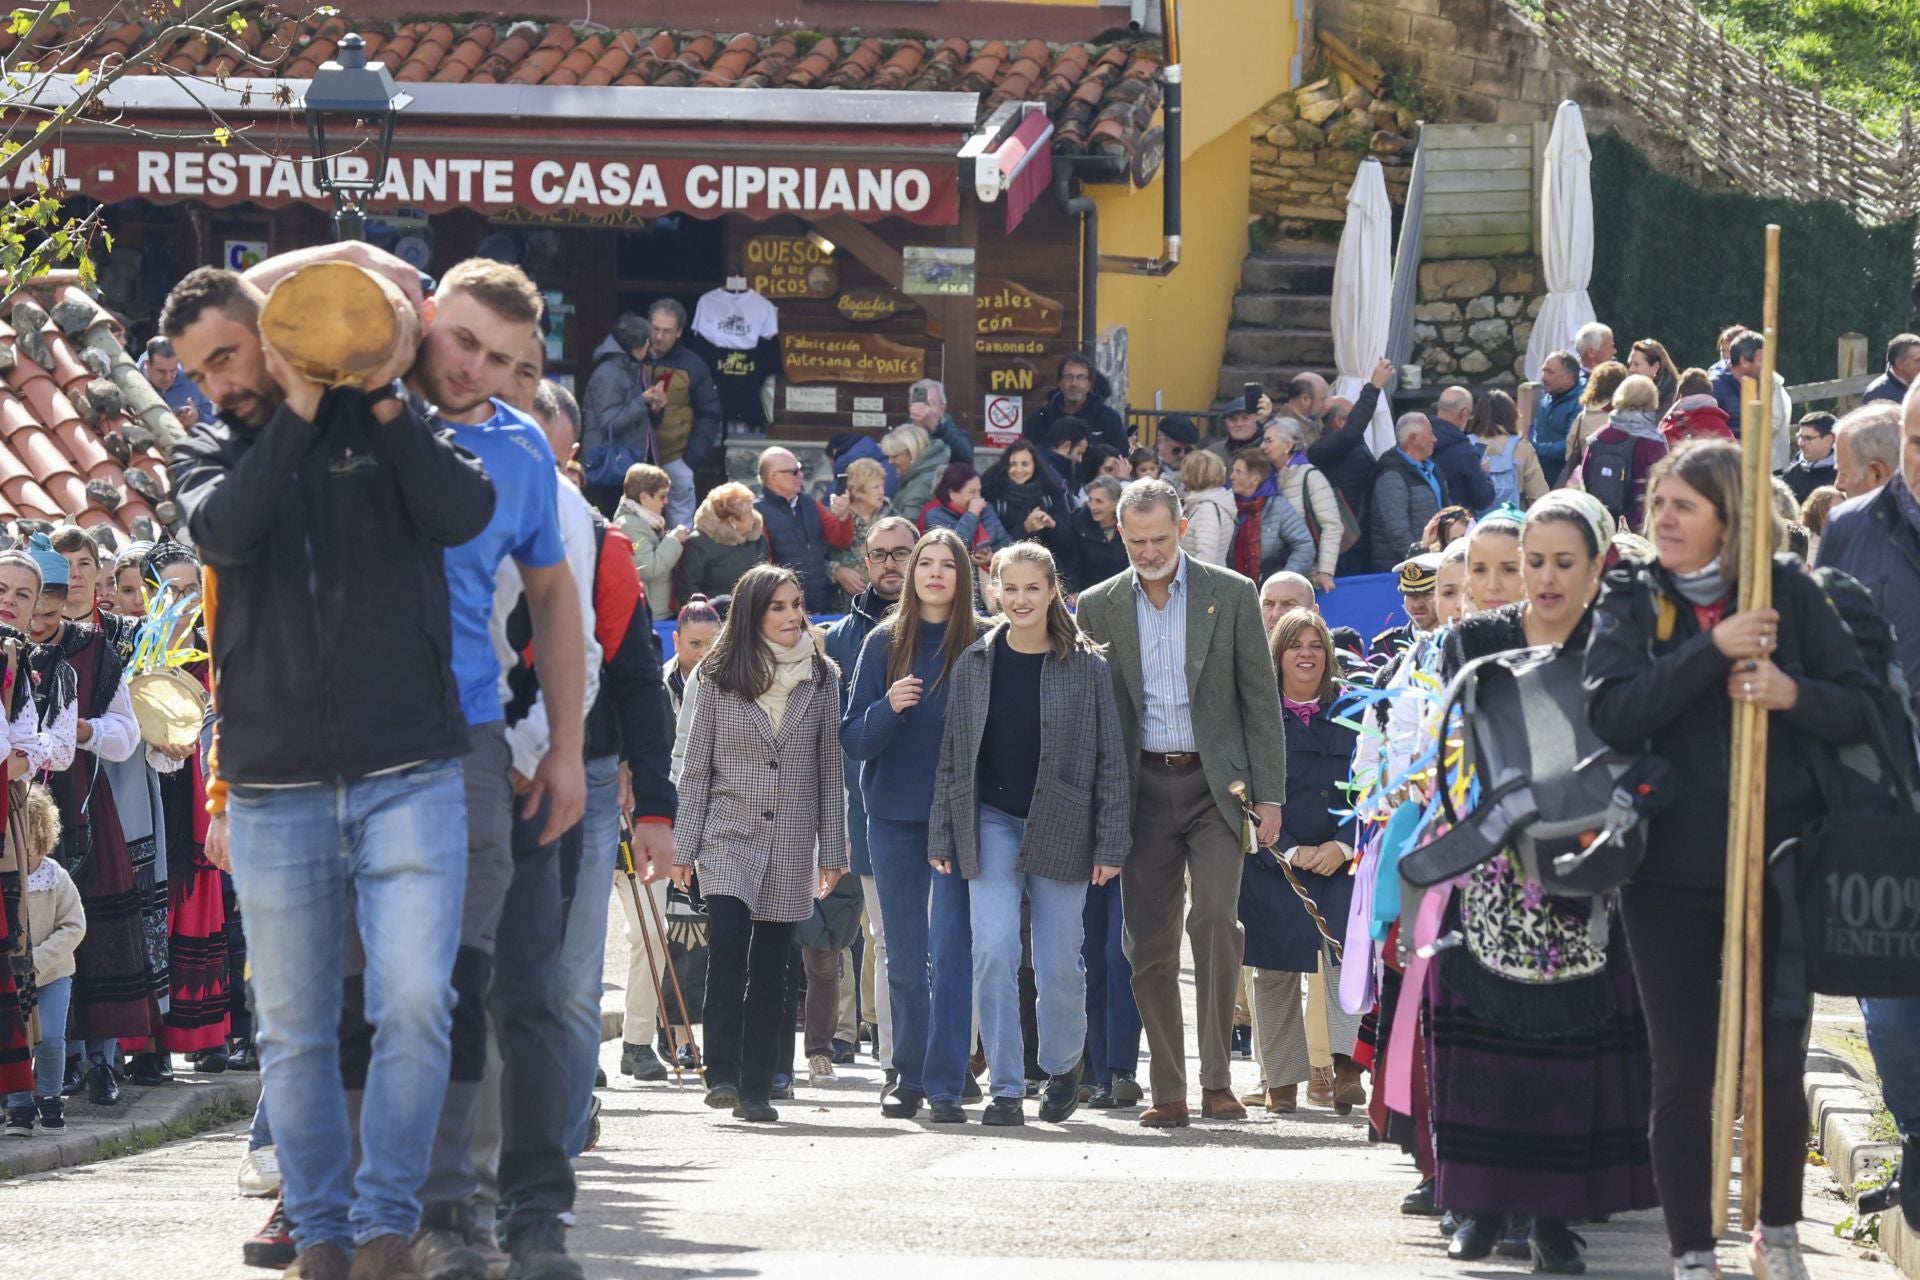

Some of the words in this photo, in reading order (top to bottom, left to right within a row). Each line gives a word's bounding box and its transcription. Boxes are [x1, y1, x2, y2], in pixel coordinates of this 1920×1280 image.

[137, 150, 513, 203] RESTAURANTE
[530, 160, 668, 206] CASA
[685, 164, 931, 212] CIPRIANO
[771, 264, 783, 276] de
[785, 335, 860, 352] Fabricación
[976, 340, 1044, 352] Gamonedo
[786, 352, 851, 368] Artesana
[991, 368, 1033, 390] PAN
